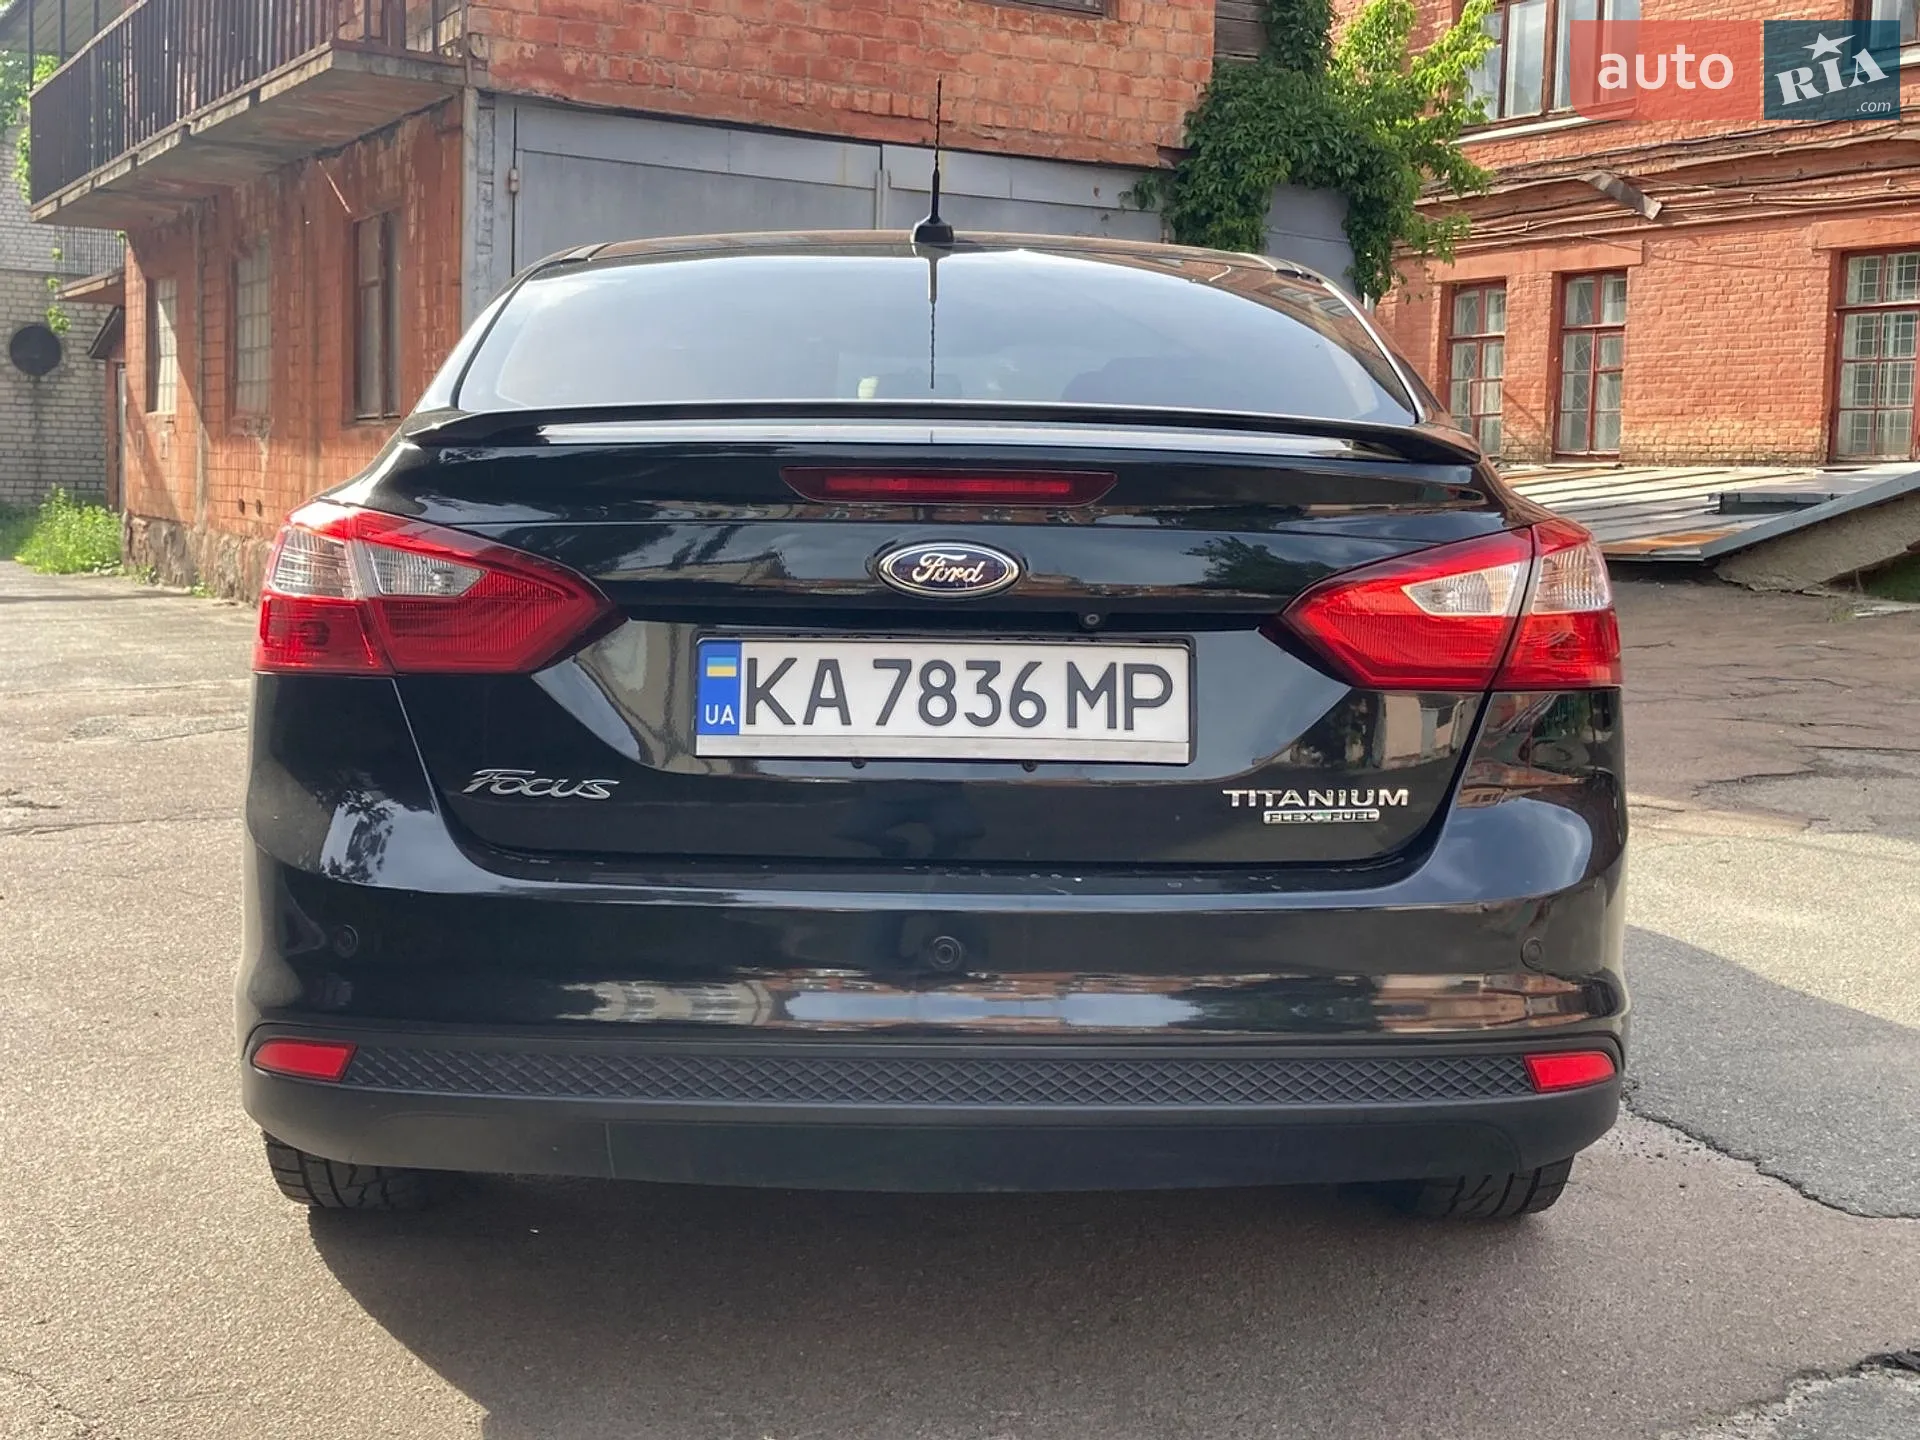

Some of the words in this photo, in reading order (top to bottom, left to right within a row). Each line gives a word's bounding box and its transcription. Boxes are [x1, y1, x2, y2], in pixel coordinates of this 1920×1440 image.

[911, 552, 986, 583] Ford
[745, 657, 852, 727] KA
[873, 658, 1048, 728] 7836
[1066, 661, 1174, 732] MP
[704, 703, 735, 725] UA
[1222, 788, 1409, 807] TITANIUM
[1269, 812, 1315, 823] FLEX
[1330, 811, 1377, 822] FUEL
